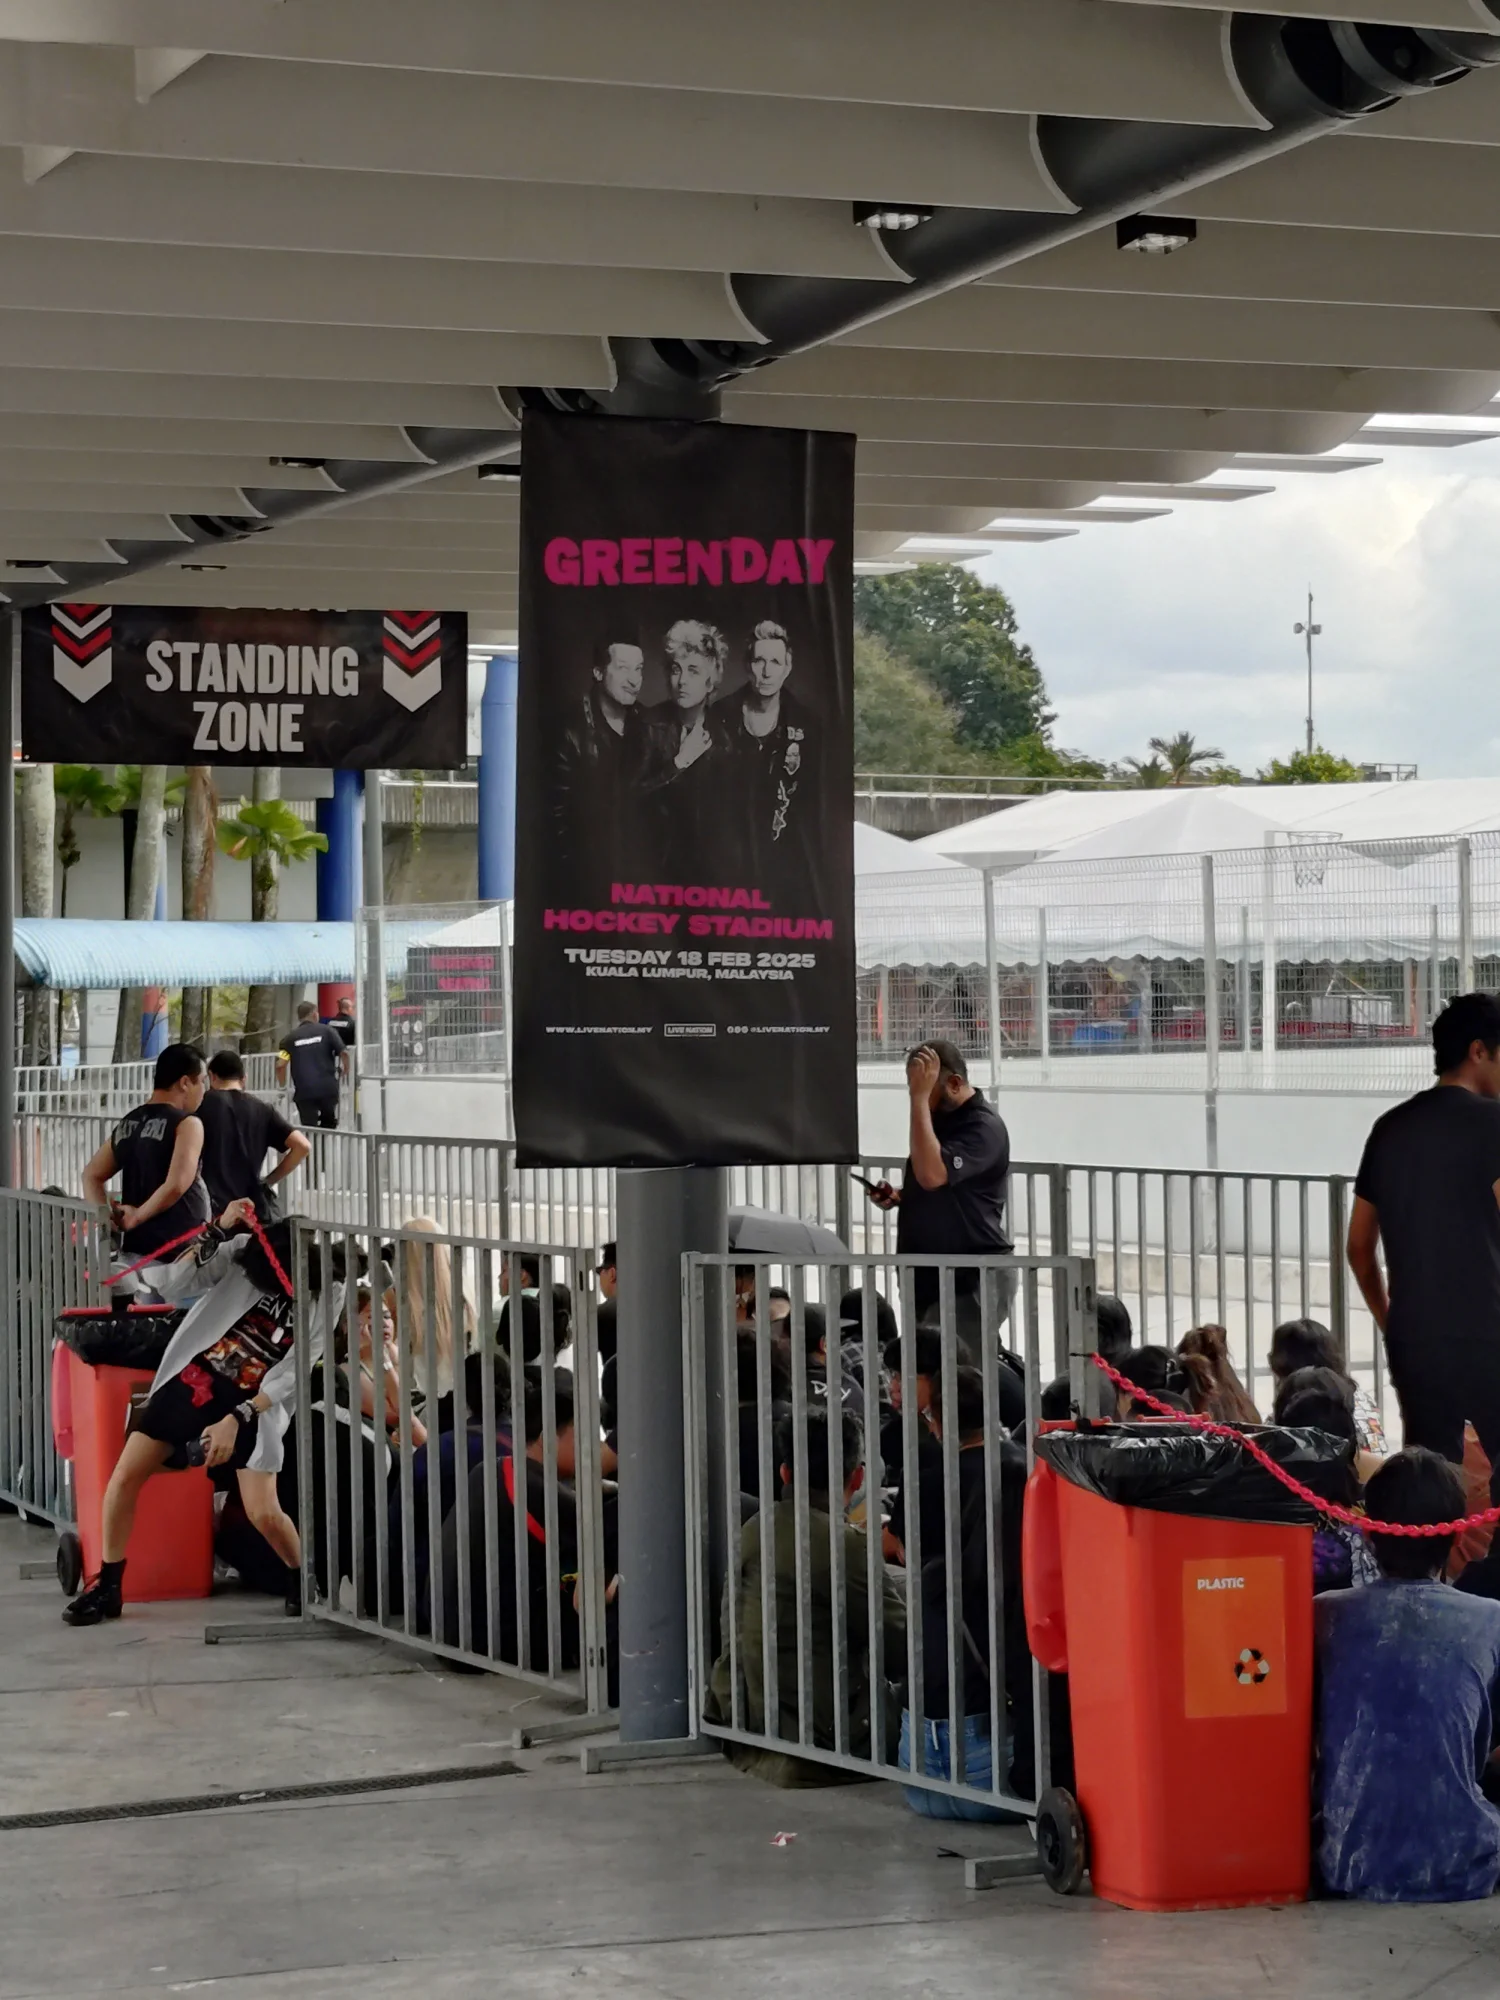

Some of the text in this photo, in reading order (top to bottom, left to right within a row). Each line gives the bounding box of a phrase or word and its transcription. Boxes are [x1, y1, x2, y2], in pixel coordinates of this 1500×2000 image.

[146, 640, 359, 697] STANDING
[193, 702, 304, 752] ZONE
[611, 883, 771, 910] NATIONAL
[544, 909, 833, 939] HOCKEY STADIUM
[563, 948, 816, 968] TUESDAY 18 FEB 2025
[585, 966, 795, 981] KUALA LUMPUR, MALAYSIA
[667, 1026, 713, 1034] LIVE NATION
[1197, 1577, 1245, 1590] PLASTIC
